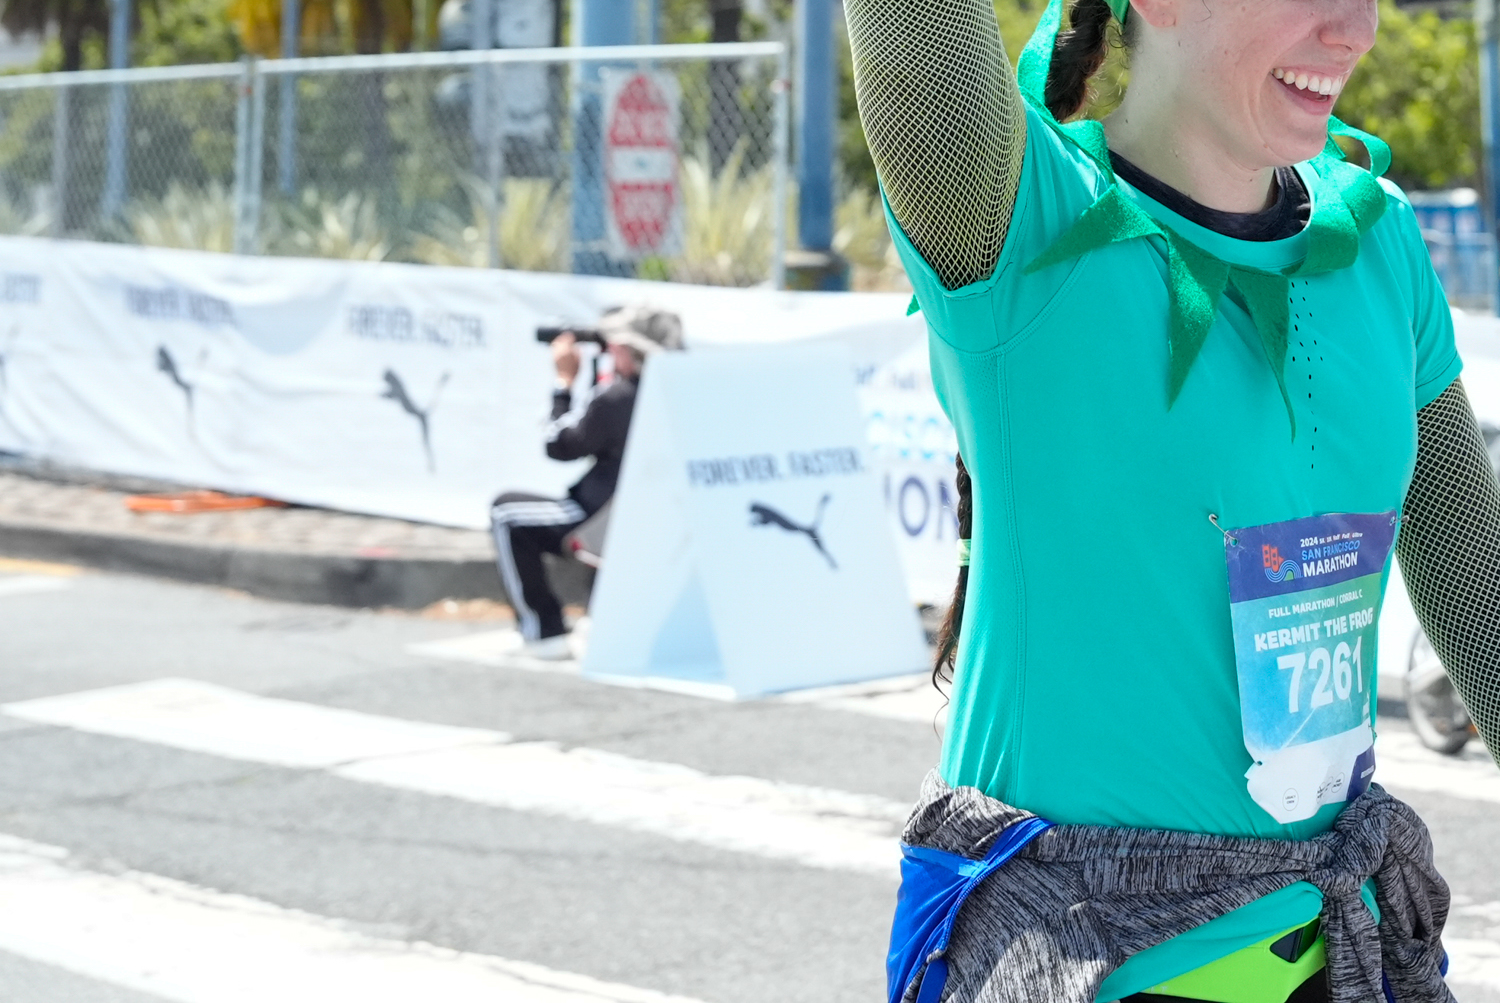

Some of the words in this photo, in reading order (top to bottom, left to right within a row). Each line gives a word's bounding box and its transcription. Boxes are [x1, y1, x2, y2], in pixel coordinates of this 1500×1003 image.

[1300, 537, 1319, 548] 2024
[1301, 547, 1322, 561] SAN
[1323, 540, 1361, 557] FRANCISCO
[1303, 551, 1358, 577] MARATHON
[1268, 606, 1292, 619] FULL
[1292, 597, 1335, 614] MARATHON
[1339, 590, 1359, 605] CORRAL
[1358, 588, 1363, 598] C
[1254, 622, 1321, 652] KERMIT
[1323, 616, 1348, 638] THE
[1348, 607, 1374, 632] FROG
[1277, 636, 1363, 714] 7261
